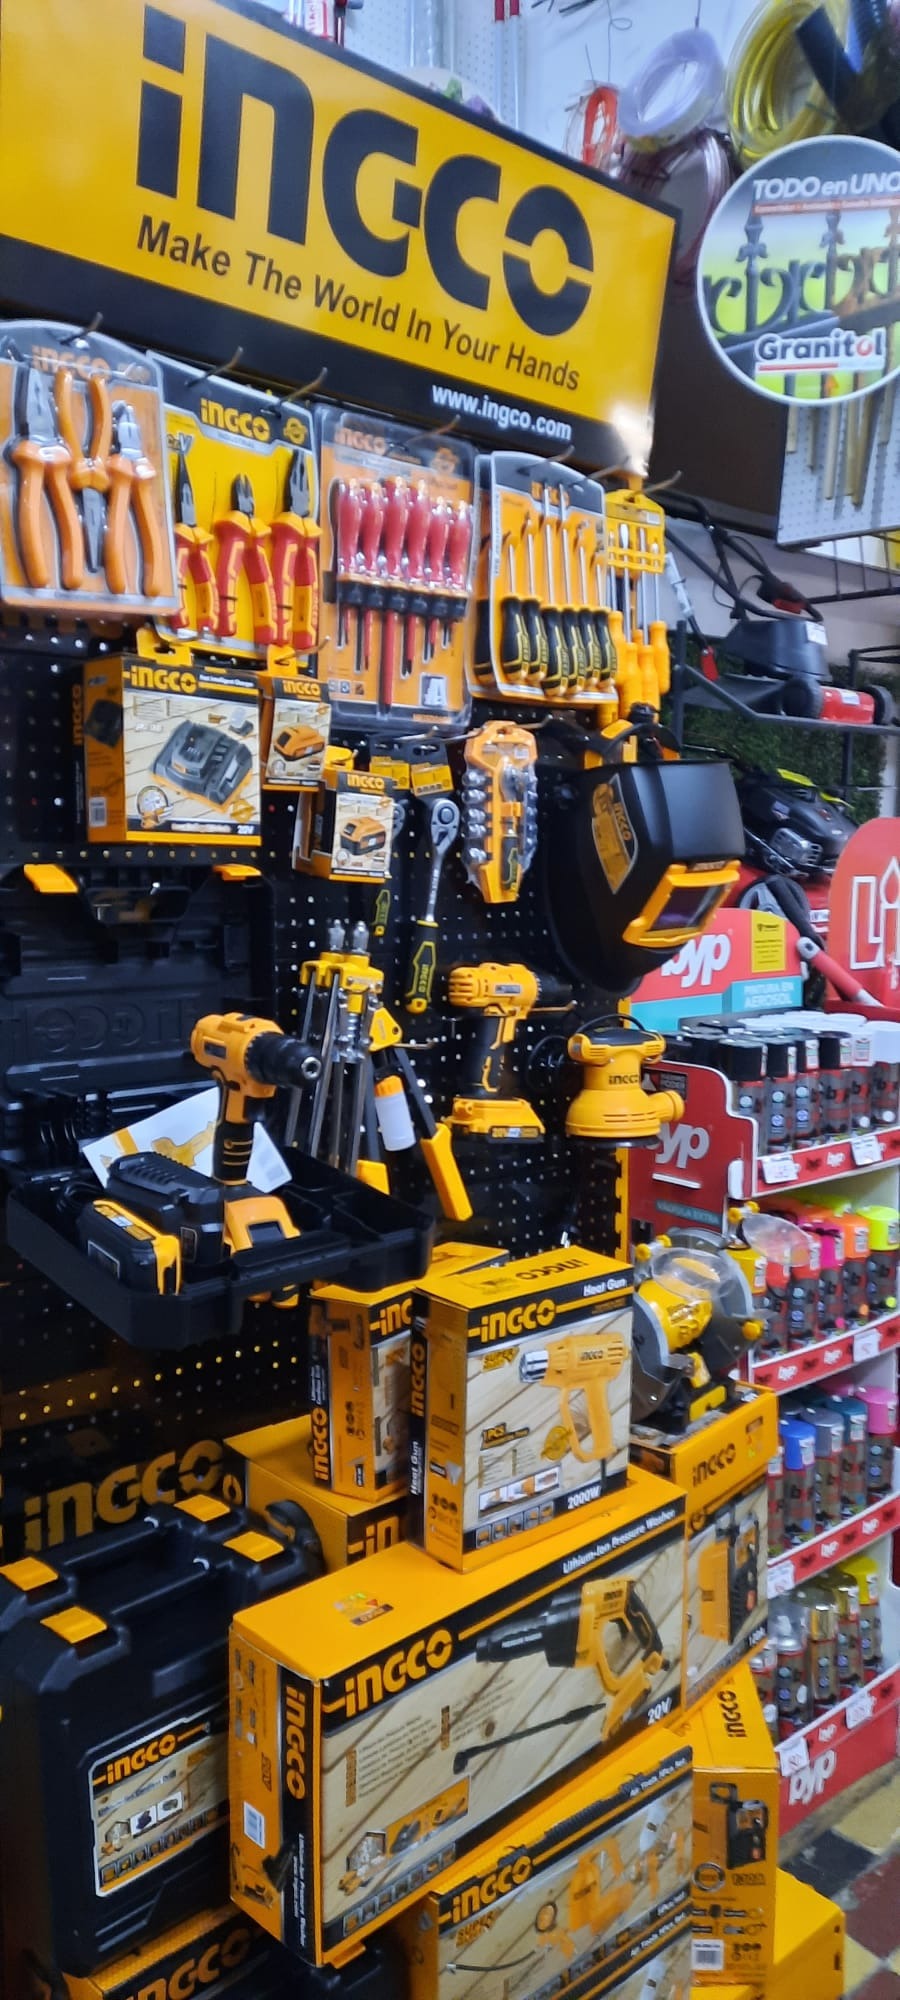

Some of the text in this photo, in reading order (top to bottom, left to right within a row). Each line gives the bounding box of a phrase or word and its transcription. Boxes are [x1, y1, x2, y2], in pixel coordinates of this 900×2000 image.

[753, 171, 900, 200] TODO en UNO
[137, 214, 579, 391] Make The World In Your Hands
[757, 328, 884, 361] Granitol
[432, 384, 572, 441] www.ingco.com
[646, 1122, 710, 1169] yp
[583, 1278, 627, 1297] Heat Gun
[567, 1484, 600, 1510] 2000W
[648, 1696, 672, 1725] 20V
